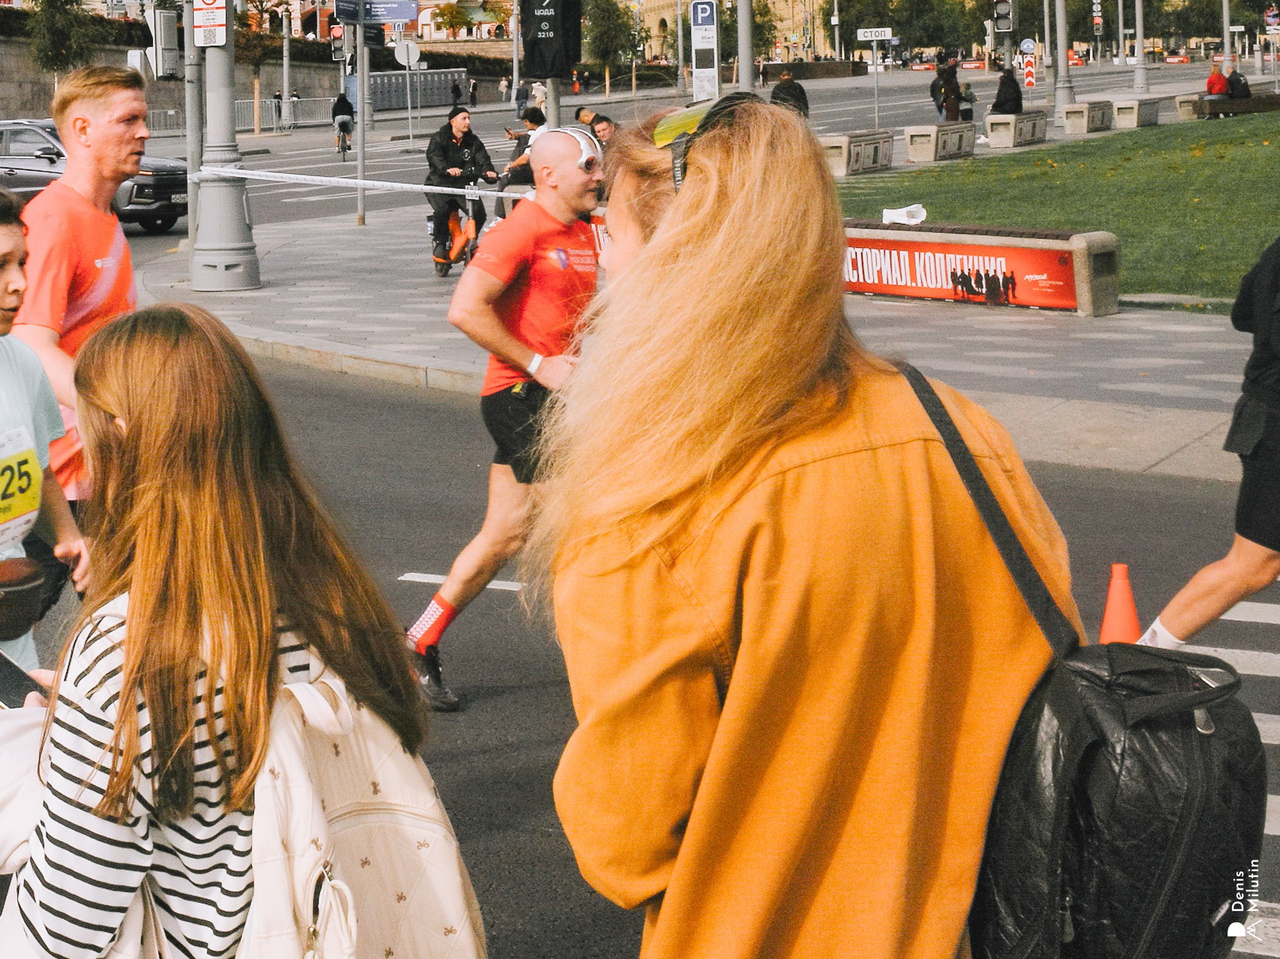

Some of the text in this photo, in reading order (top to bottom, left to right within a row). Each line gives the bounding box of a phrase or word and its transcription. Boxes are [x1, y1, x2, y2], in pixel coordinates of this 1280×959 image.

[534, 8, 555, 16] ЦОДД
[697, 4, 711, 24] P
[863, 30, 886, 39] СТОП
